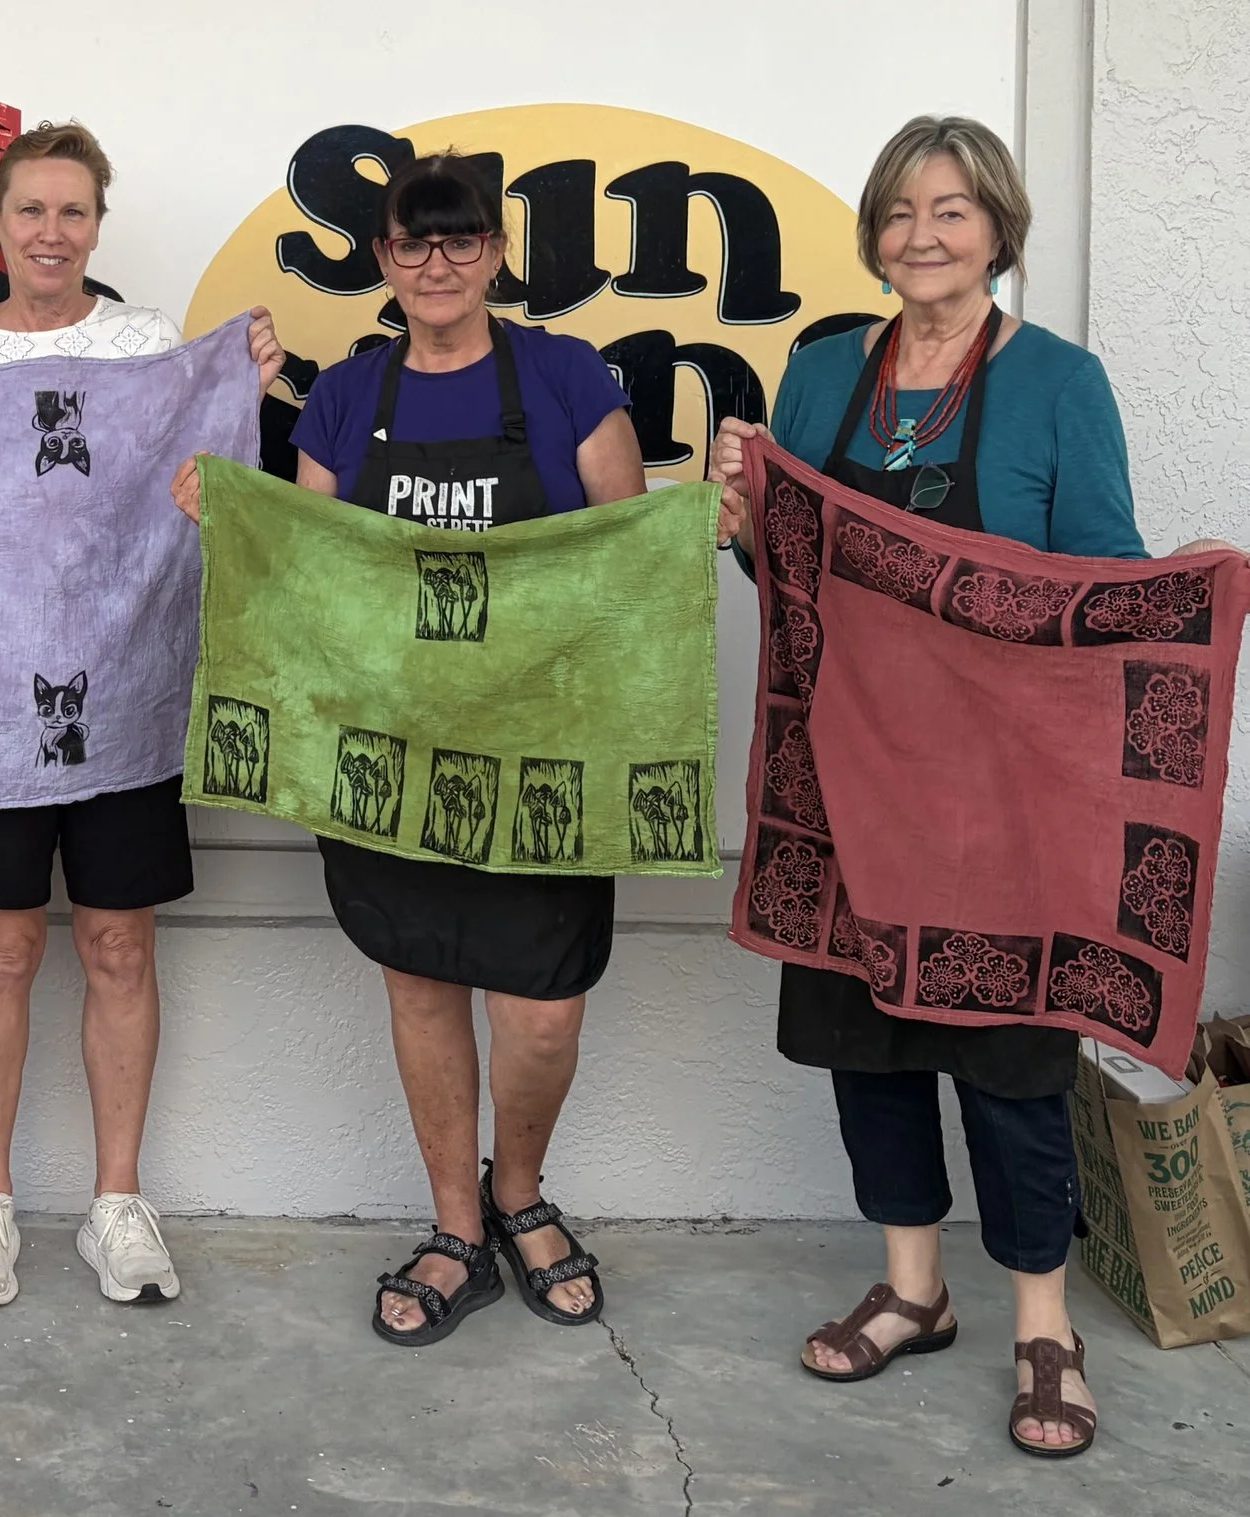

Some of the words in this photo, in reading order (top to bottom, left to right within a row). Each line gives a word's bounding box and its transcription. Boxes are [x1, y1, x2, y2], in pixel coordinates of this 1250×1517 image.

[276, 124, 801, 325] Sun
[387, 475, 499, 518] PRINT
[1137, 1120, 1172, 1140] WE
[1173, 1105, 1199, 1137] BAN
[1144, 1135, 1199, 1183] 300
[1179, 1242, 1224, 1285] PEACE
[1188, 1276, 1235, 1320] MIND
